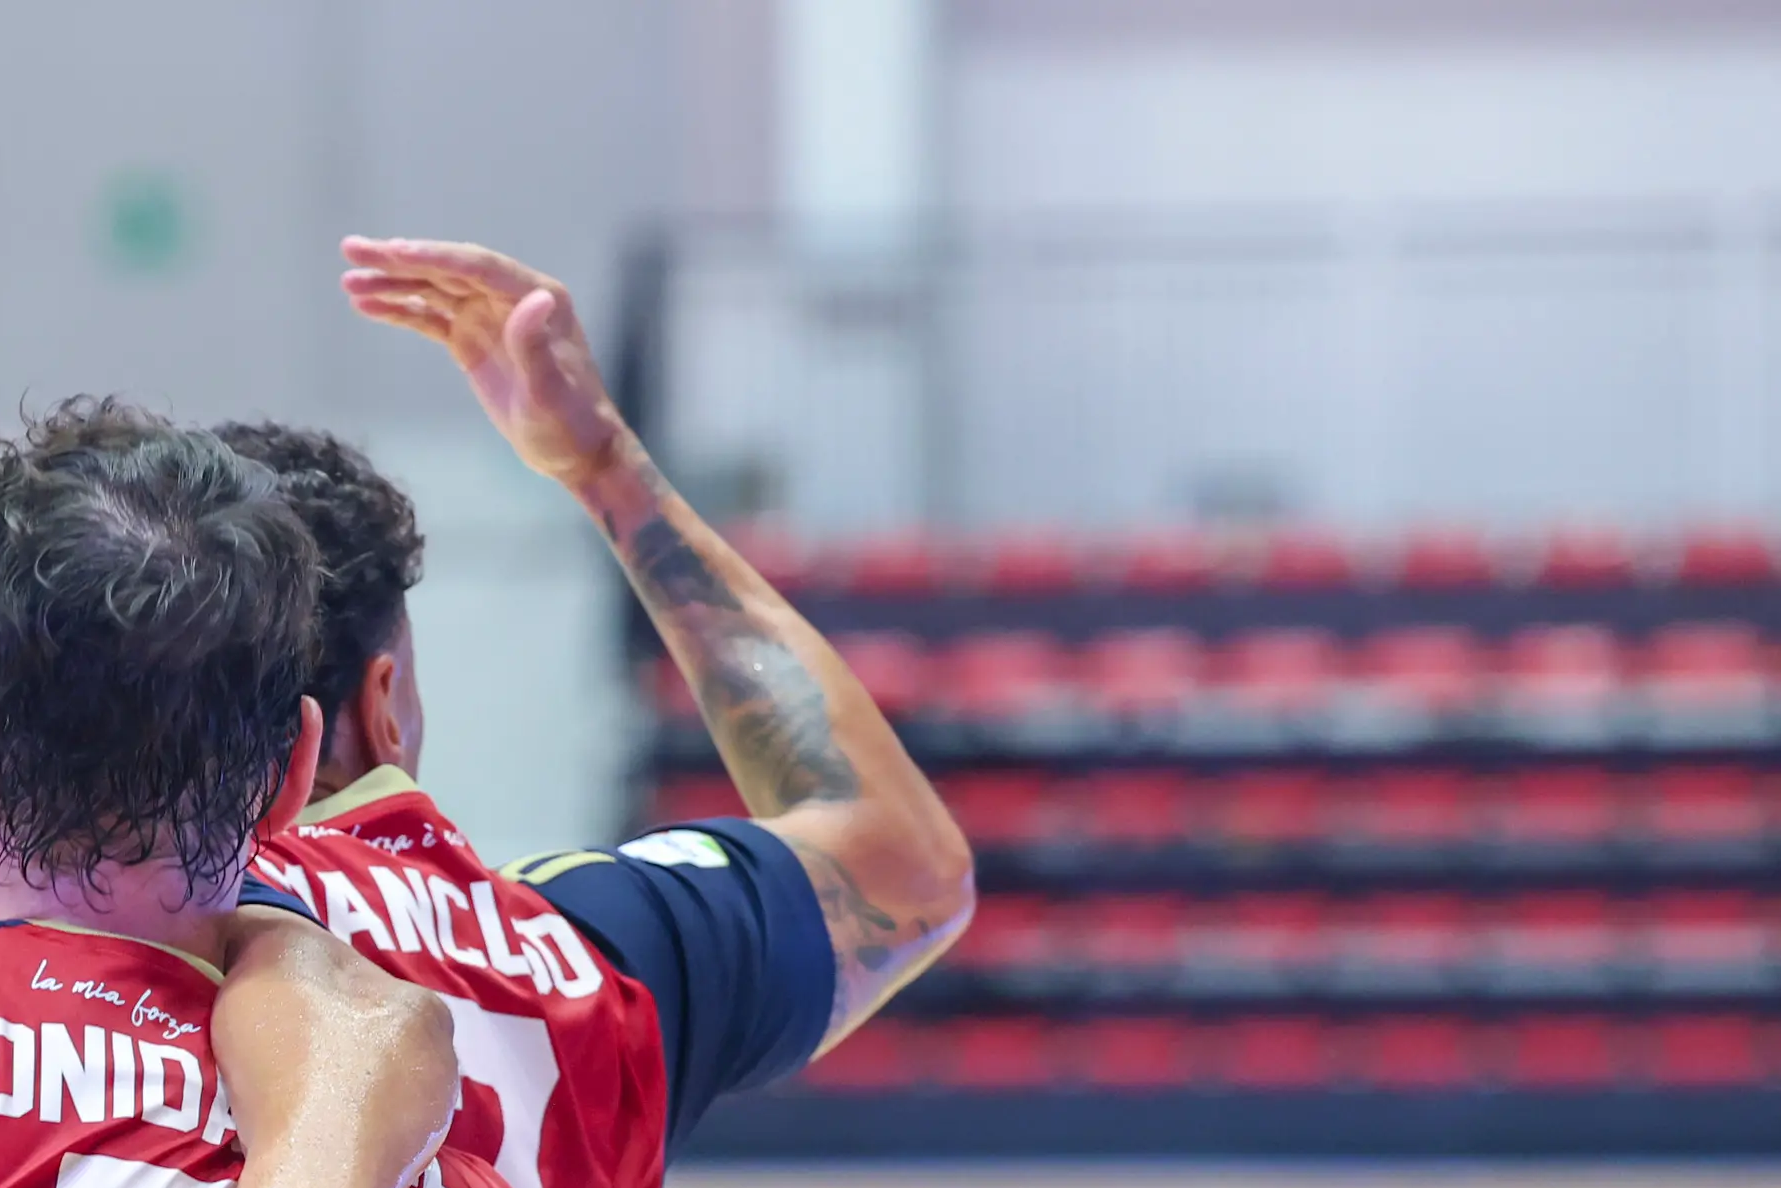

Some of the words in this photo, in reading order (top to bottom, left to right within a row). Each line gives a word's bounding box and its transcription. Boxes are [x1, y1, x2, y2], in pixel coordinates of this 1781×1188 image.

[31, 959, 63, 991] la
[72, 980, 125, 1005] mia
[131, 989, 201, 1039] forza
